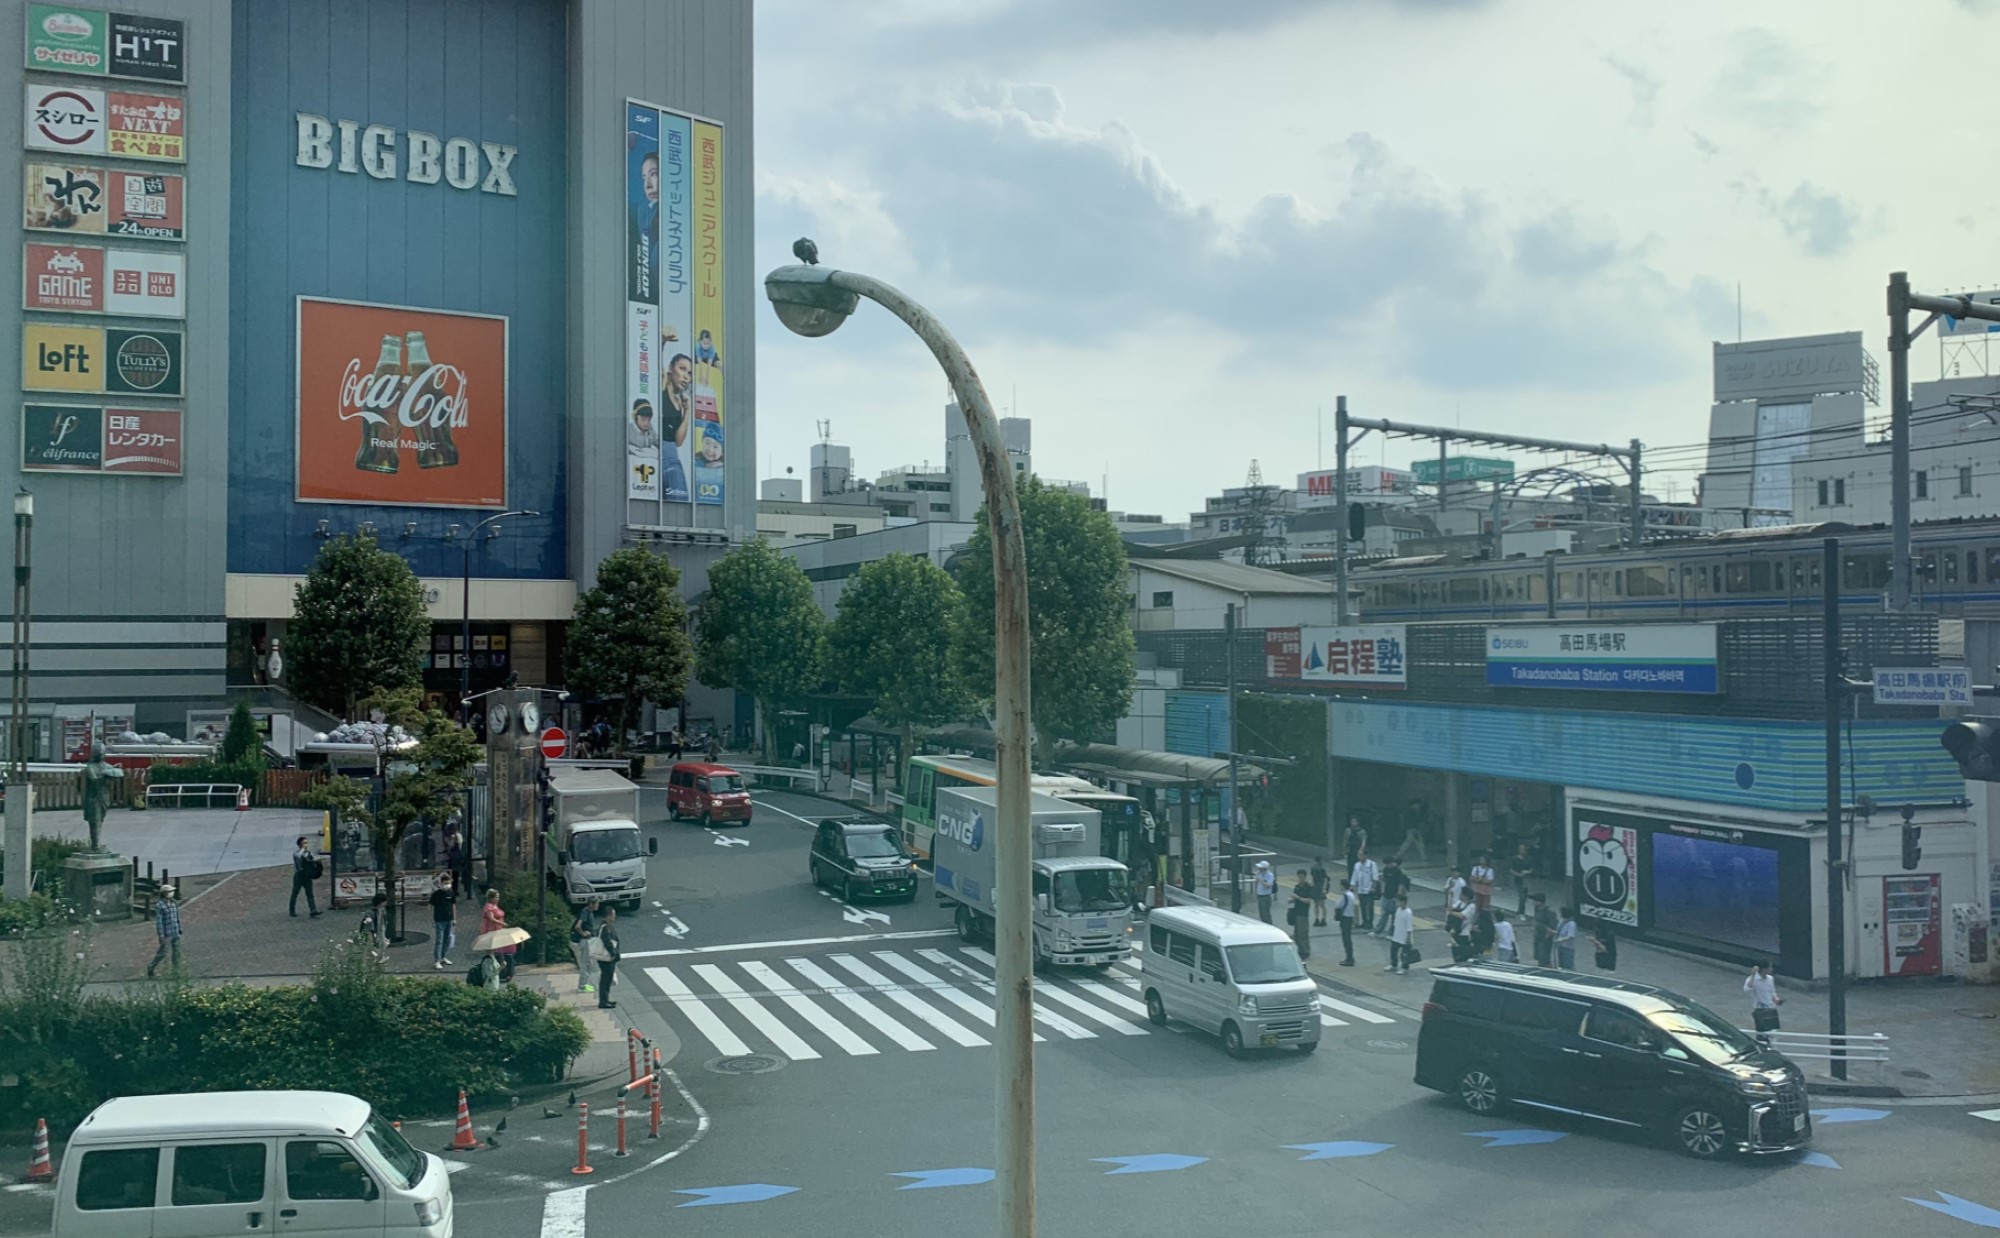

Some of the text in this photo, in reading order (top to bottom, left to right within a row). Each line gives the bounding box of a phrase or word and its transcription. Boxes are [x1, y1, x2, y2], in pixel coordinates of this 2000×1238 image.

[35, 109, 99, 125] スシロー
[121, 117, 171, 133] NEXT
[111, 139, 180, 158] 食べ放題
[296, 111, 518, 196] BIG BOX
[45, 170, 101, 214] わん
[641, 234, 650, 298] DUNLOP
[38, 275, 92, 298] GAME
[338, 357, 469, 428] Coca-Cola
[109, 415, 141, 431] 日産
[109, 433, 175, 446] レンタカー
[370, 437, 437, 451] Real Magic
[1502, 638, 1529, 649] SEIBU
[1559, 633, 1627, 652] 高田馬場駅
[1511, 666, 1618, 682] Takadanobaba Station
[1878, 673, 1967, 688] 高田馬場駅前
[1880, 689, 1969, 701] Takadanobaba Sta.
[938, 813, 973, 845] CNG
